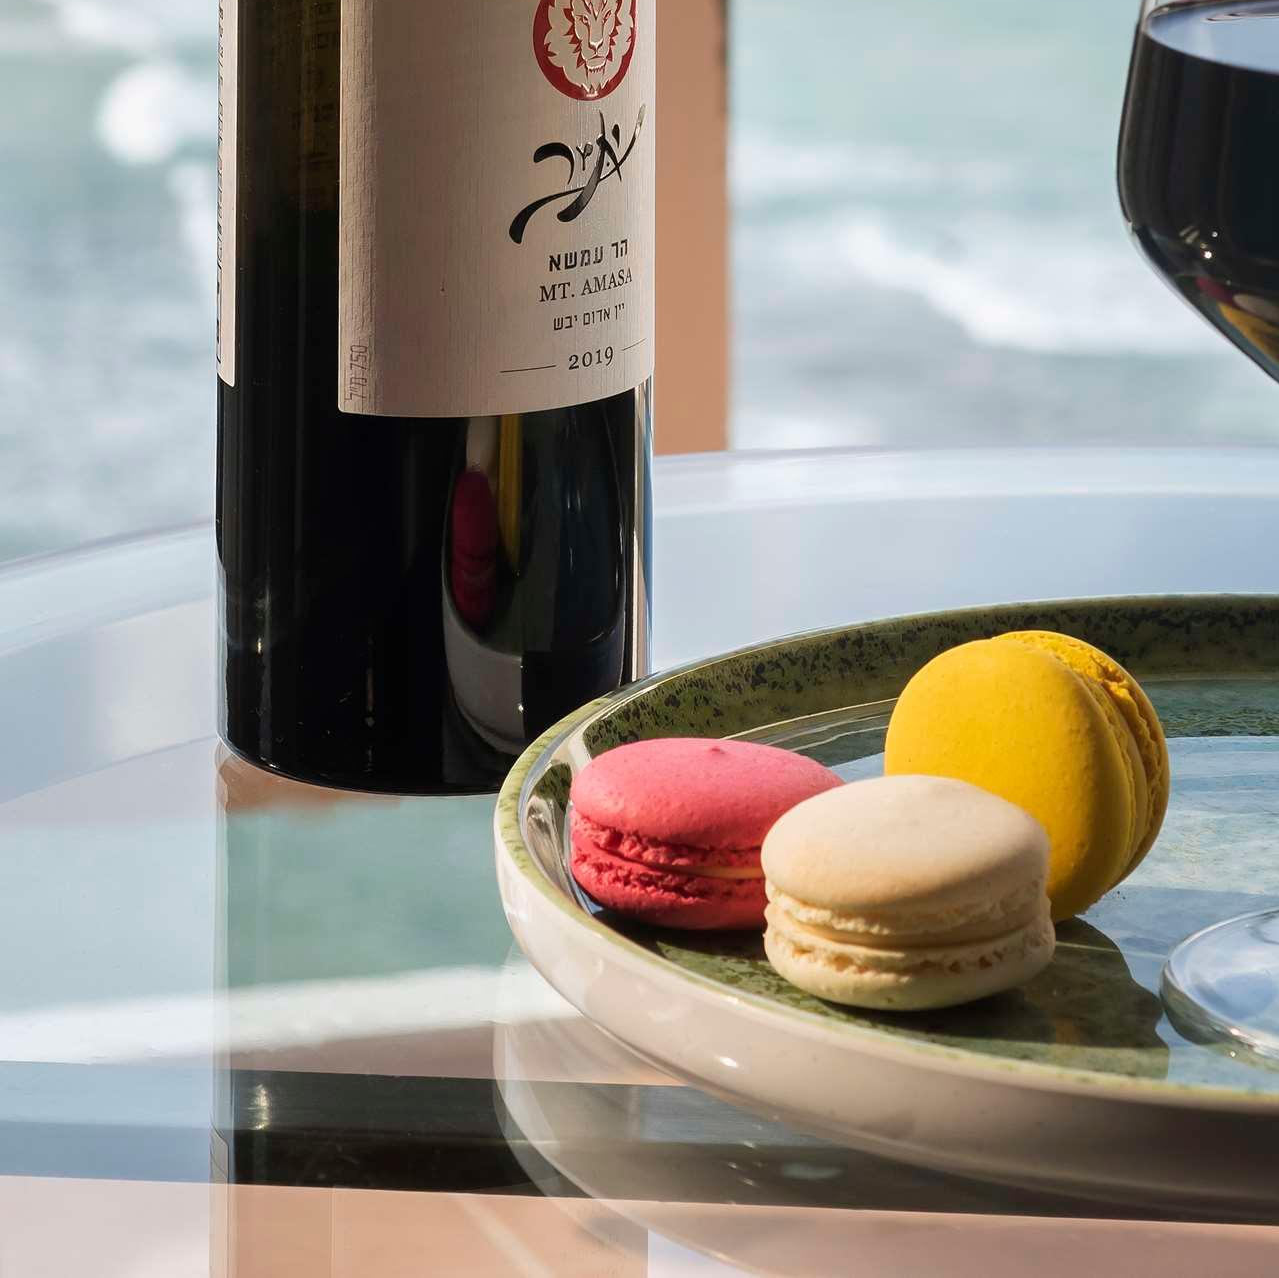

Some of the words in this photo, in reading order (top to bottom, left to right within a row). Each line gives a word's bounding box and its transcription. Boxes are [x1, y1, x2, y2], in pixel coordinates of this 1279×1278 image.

[548, 246, 604, 272] עמשא
[611, 239, 628, 259] הר
[539, 282, 575, 302] MT.
[581, 267, 633, 296] AMASA
[553, 314, 578, 331] יבש
[583, 307, 611, 326] אדום
[614, 303, 625, 320] יין
[350, 344, 367, 370] 750
[568, 346, 614, 370] 2019
